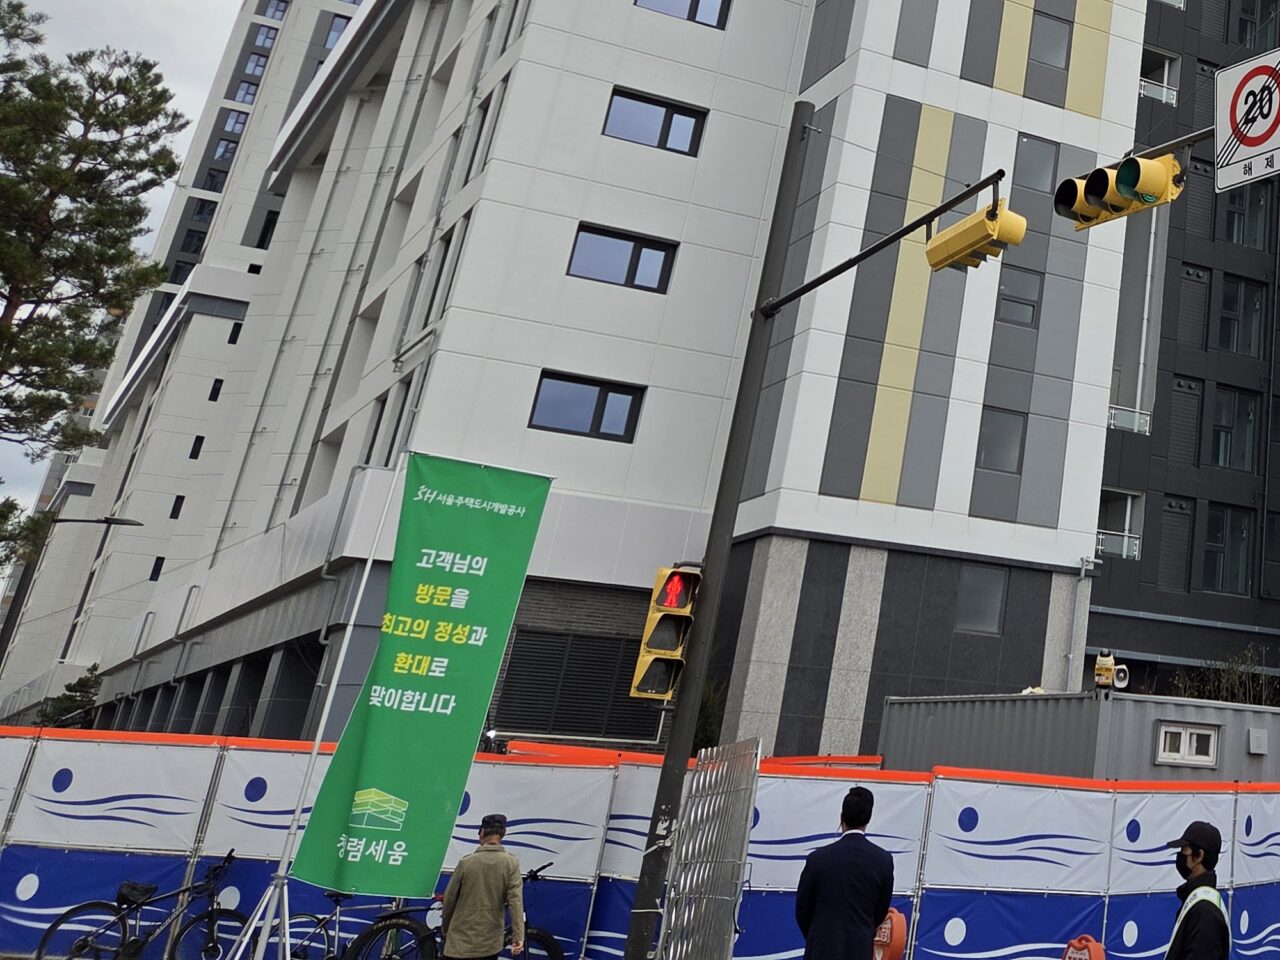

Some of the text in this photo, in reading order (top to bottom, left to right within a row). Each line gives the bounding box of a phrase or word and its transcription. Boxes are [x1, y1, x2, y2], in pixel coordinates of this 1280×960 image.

[1244, 85, 1273, 126] 20
[414, 485, 526, 518] SH 서울주택도시개발공사
[416, 548, 488, 576] 고객님의
[415, 584, 469, 609] 방문을
[381, 613, 488, 647] 최고의 정성과
[393, 652, 449, 677] 환대로
[369, 685, 456, 715] 맞이합니다
[337, 833, 408, 865] 청렴세움
